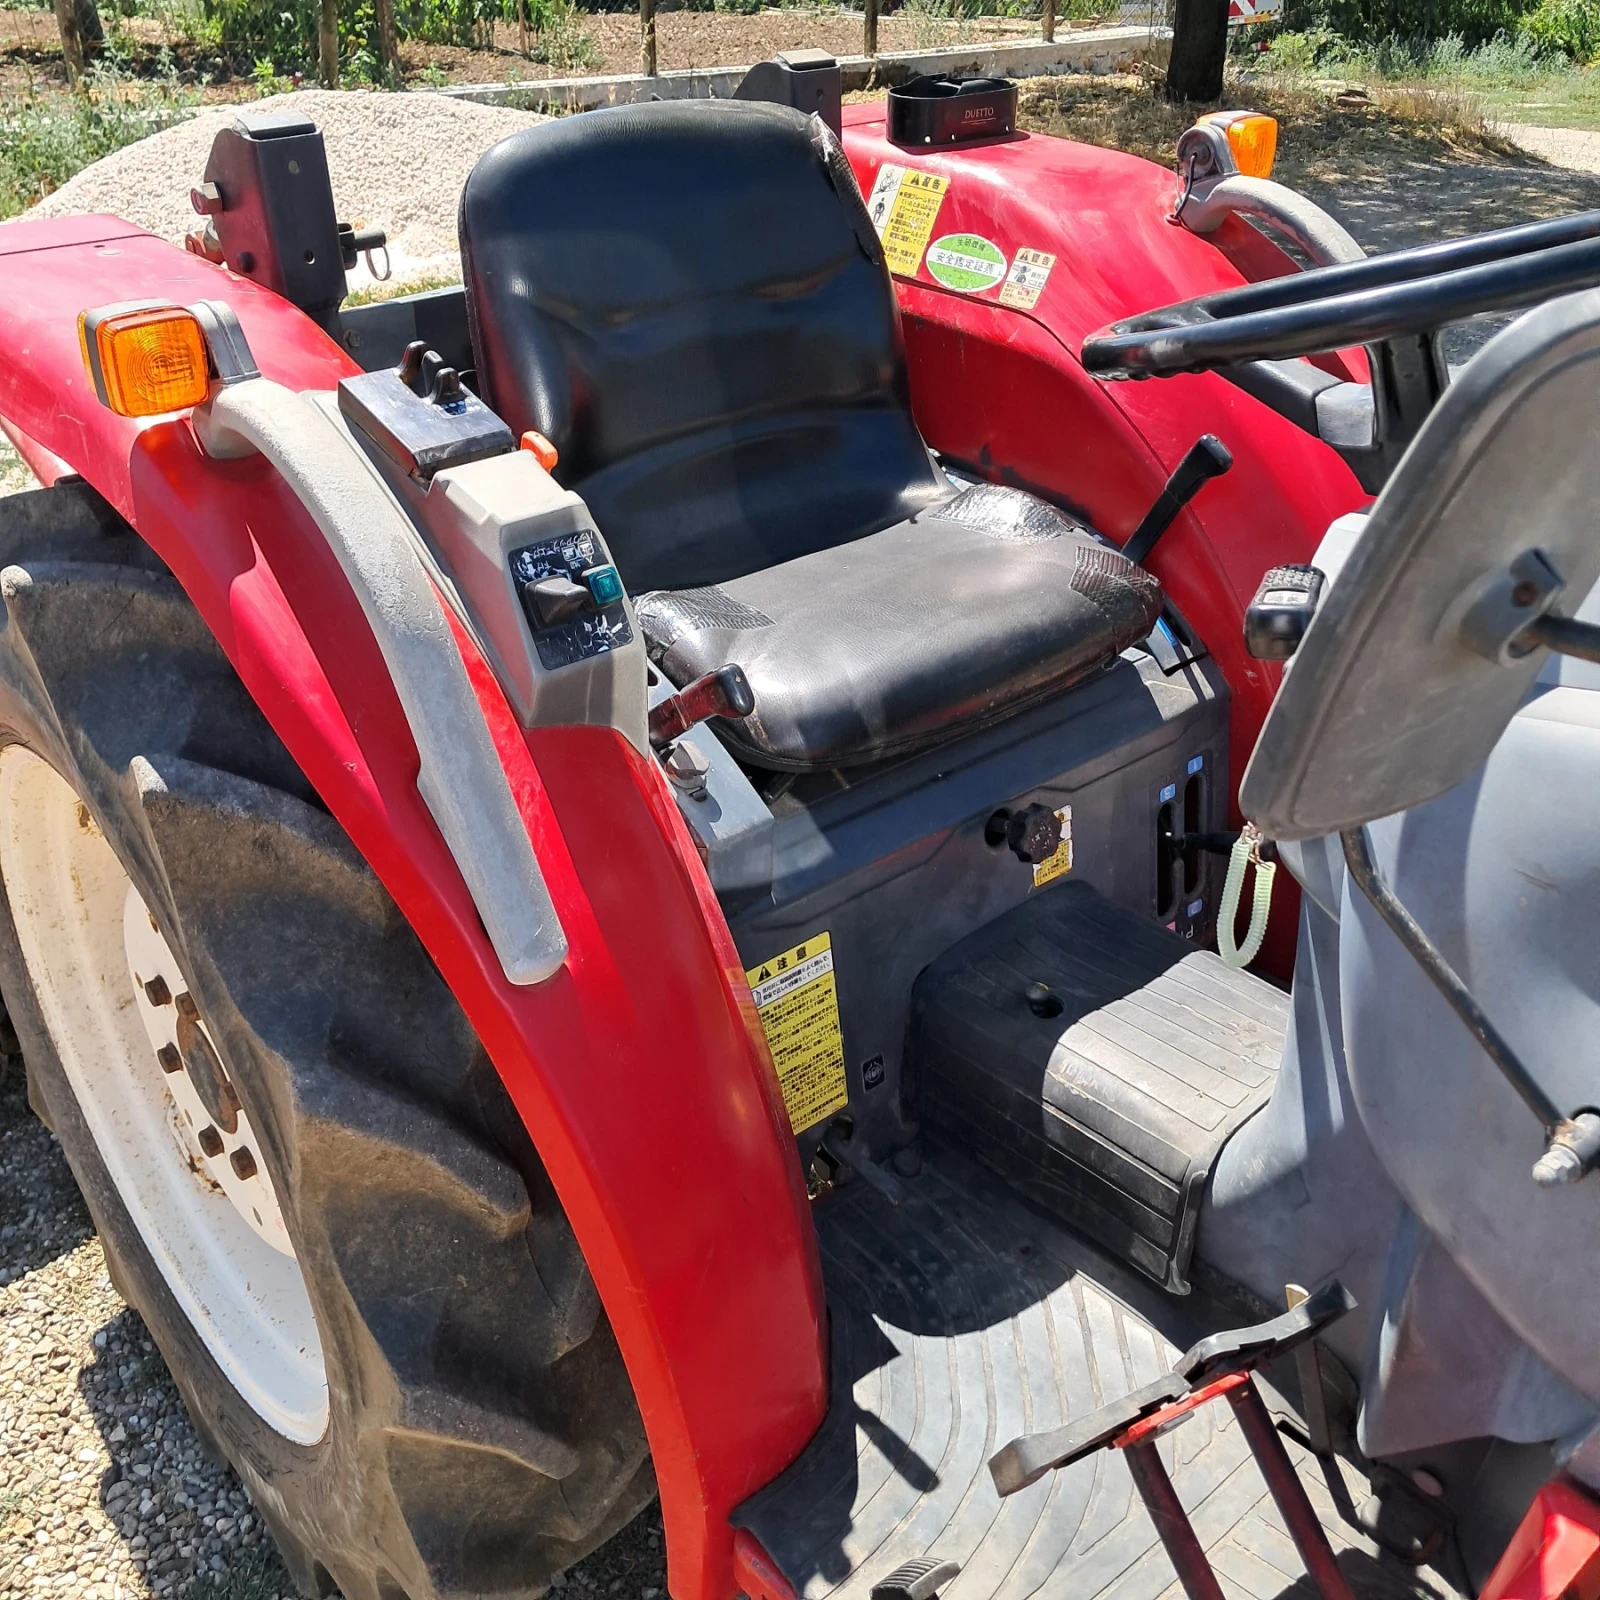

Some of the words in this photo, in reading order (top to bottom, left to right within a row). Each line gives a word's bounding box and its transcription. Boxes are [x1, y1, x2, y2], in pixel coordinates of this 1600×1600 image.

[964, 106, 994, 119] DUETTO
[922, 176, 941, 190] 警告
[936, 251, 995, 275] 安全鑑定証票
[777, 946, 807, 970] 注意
